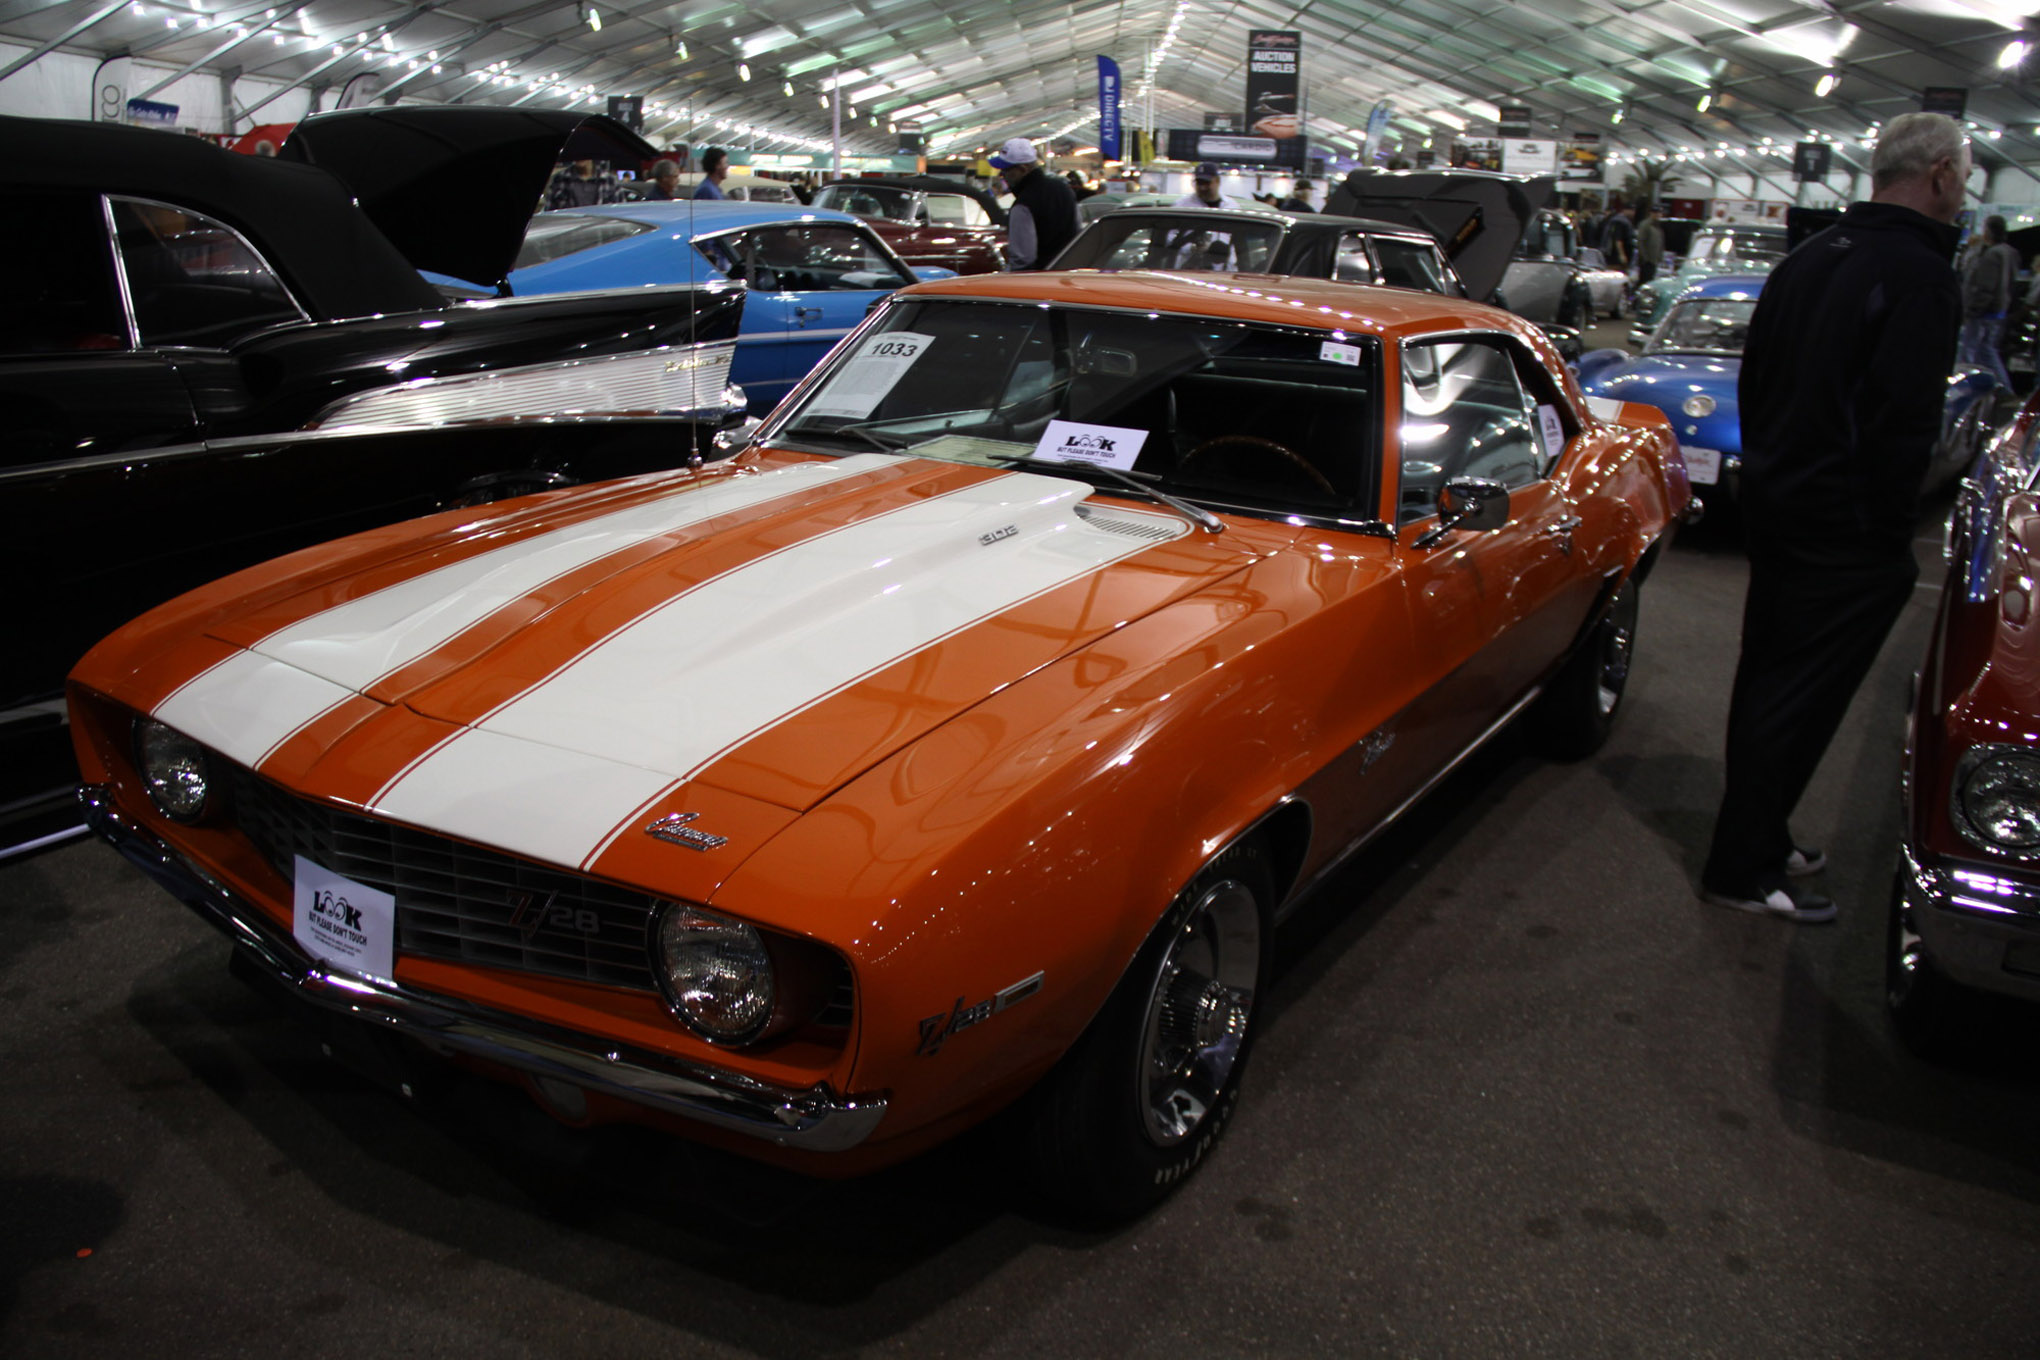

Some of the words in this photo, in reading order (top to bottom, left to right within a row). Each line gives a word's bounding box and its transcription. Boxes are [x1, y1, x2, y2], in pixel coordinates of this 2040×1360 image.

[1253, 51, 1296, 62] AUCTION
[1250, 62, 1297, 74] VEHICLES
[1104, 95, 1115, 141] DIRECTV
[872, 342, 918, 357] 1033
[1065, 434, 1116, 451] LOOK
[313, 890, 362, 931] LOOK
[317, 914, 332, 933] PLEASE
[349, 931, 367, 946] TOUCH
